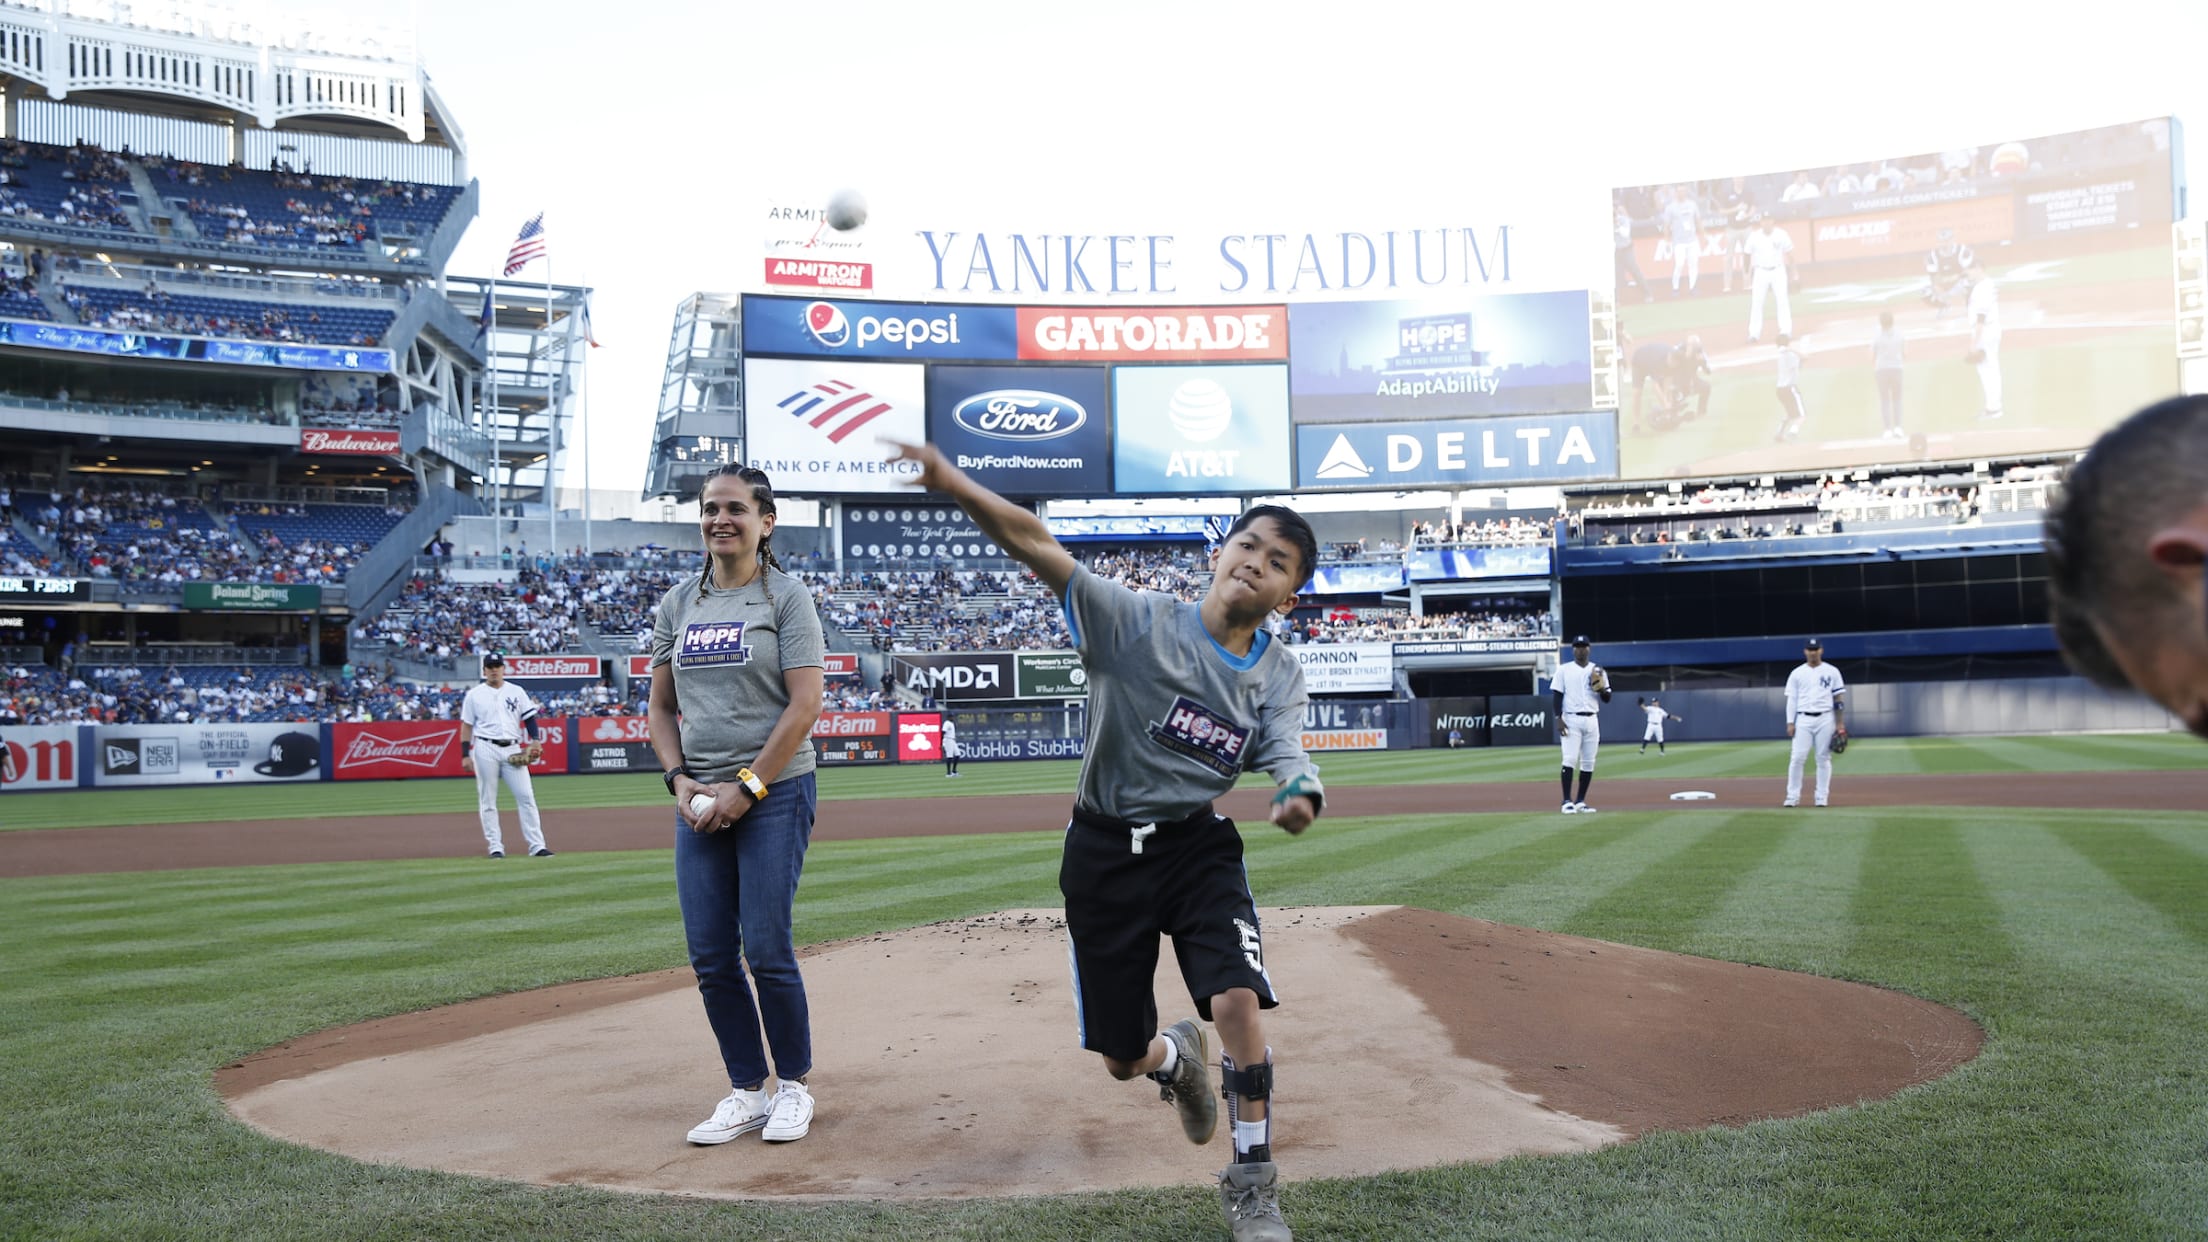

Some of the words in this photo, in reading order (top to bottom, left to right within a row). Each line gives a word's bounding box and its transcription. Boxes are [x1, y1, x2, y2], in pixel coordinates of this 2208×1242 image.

[1819, 220, 1891, 241] MAXXIS
[915, 231, 1176, 295] YANKEE
[1218, 224, 1514, 293] STADIUM
[773, 261, 865, 279] ARMITRON
[856, 312, 961, 349] pepsi
[1034, 314, 1271, 352] GATORADE
[1376, 375, 1500, 398] AdaptAbility
[979, 396, 1060, 432] Ford
[303, 431, 399, 451] Budweiser
[1386, 425, 1597, 474] DELTA
[750, 459, 802, 473] BANK
[808, 460, 832, 473] OF
[836, 461, 921, 474] AMERICA
[957, 455, 1084, 470] BuyFordNow.com
[1165, 449, 1241, 478] AT&T
[900, 526, 922, 537] New
[921, 526, 945, 541] York
[944, 526, 981, 541] Yankees
[33, 579, 77, 593] FIRST
[212, 584, 251, 600] Poland
[251, 585, 289, 603] Spring
[685, 627, 741, 646] HOPE
[1515, 640, 1557, 650] COLLECTIBLES
[1299, 650, 1358, 665] DANNON
[907, 666, 975, 689] AMD
[1329, 667, 1352, 676] BRONX
[1354, 666, 1388, 675] DYNASTY
[1035, 684, 1054, 693] What
[1170, 707, 1243, 755] HOPE
[145, 745, 174, 755] NEW
[199, 739, 250, 750] ON-FIELD
[351, 739, 444, 758] Budweiser
[591, 747, 627, 758] ASTROS
[957, 741, 1020, 758] StubHub
[1027, 739, 1084, 757] StubHu
[146, 755, 174, 768] ERA
[590, 758, 629, 769] YANKEES
[822, 751, 848, 761] STRIKE
[863, 750, 879, 760] OUT
